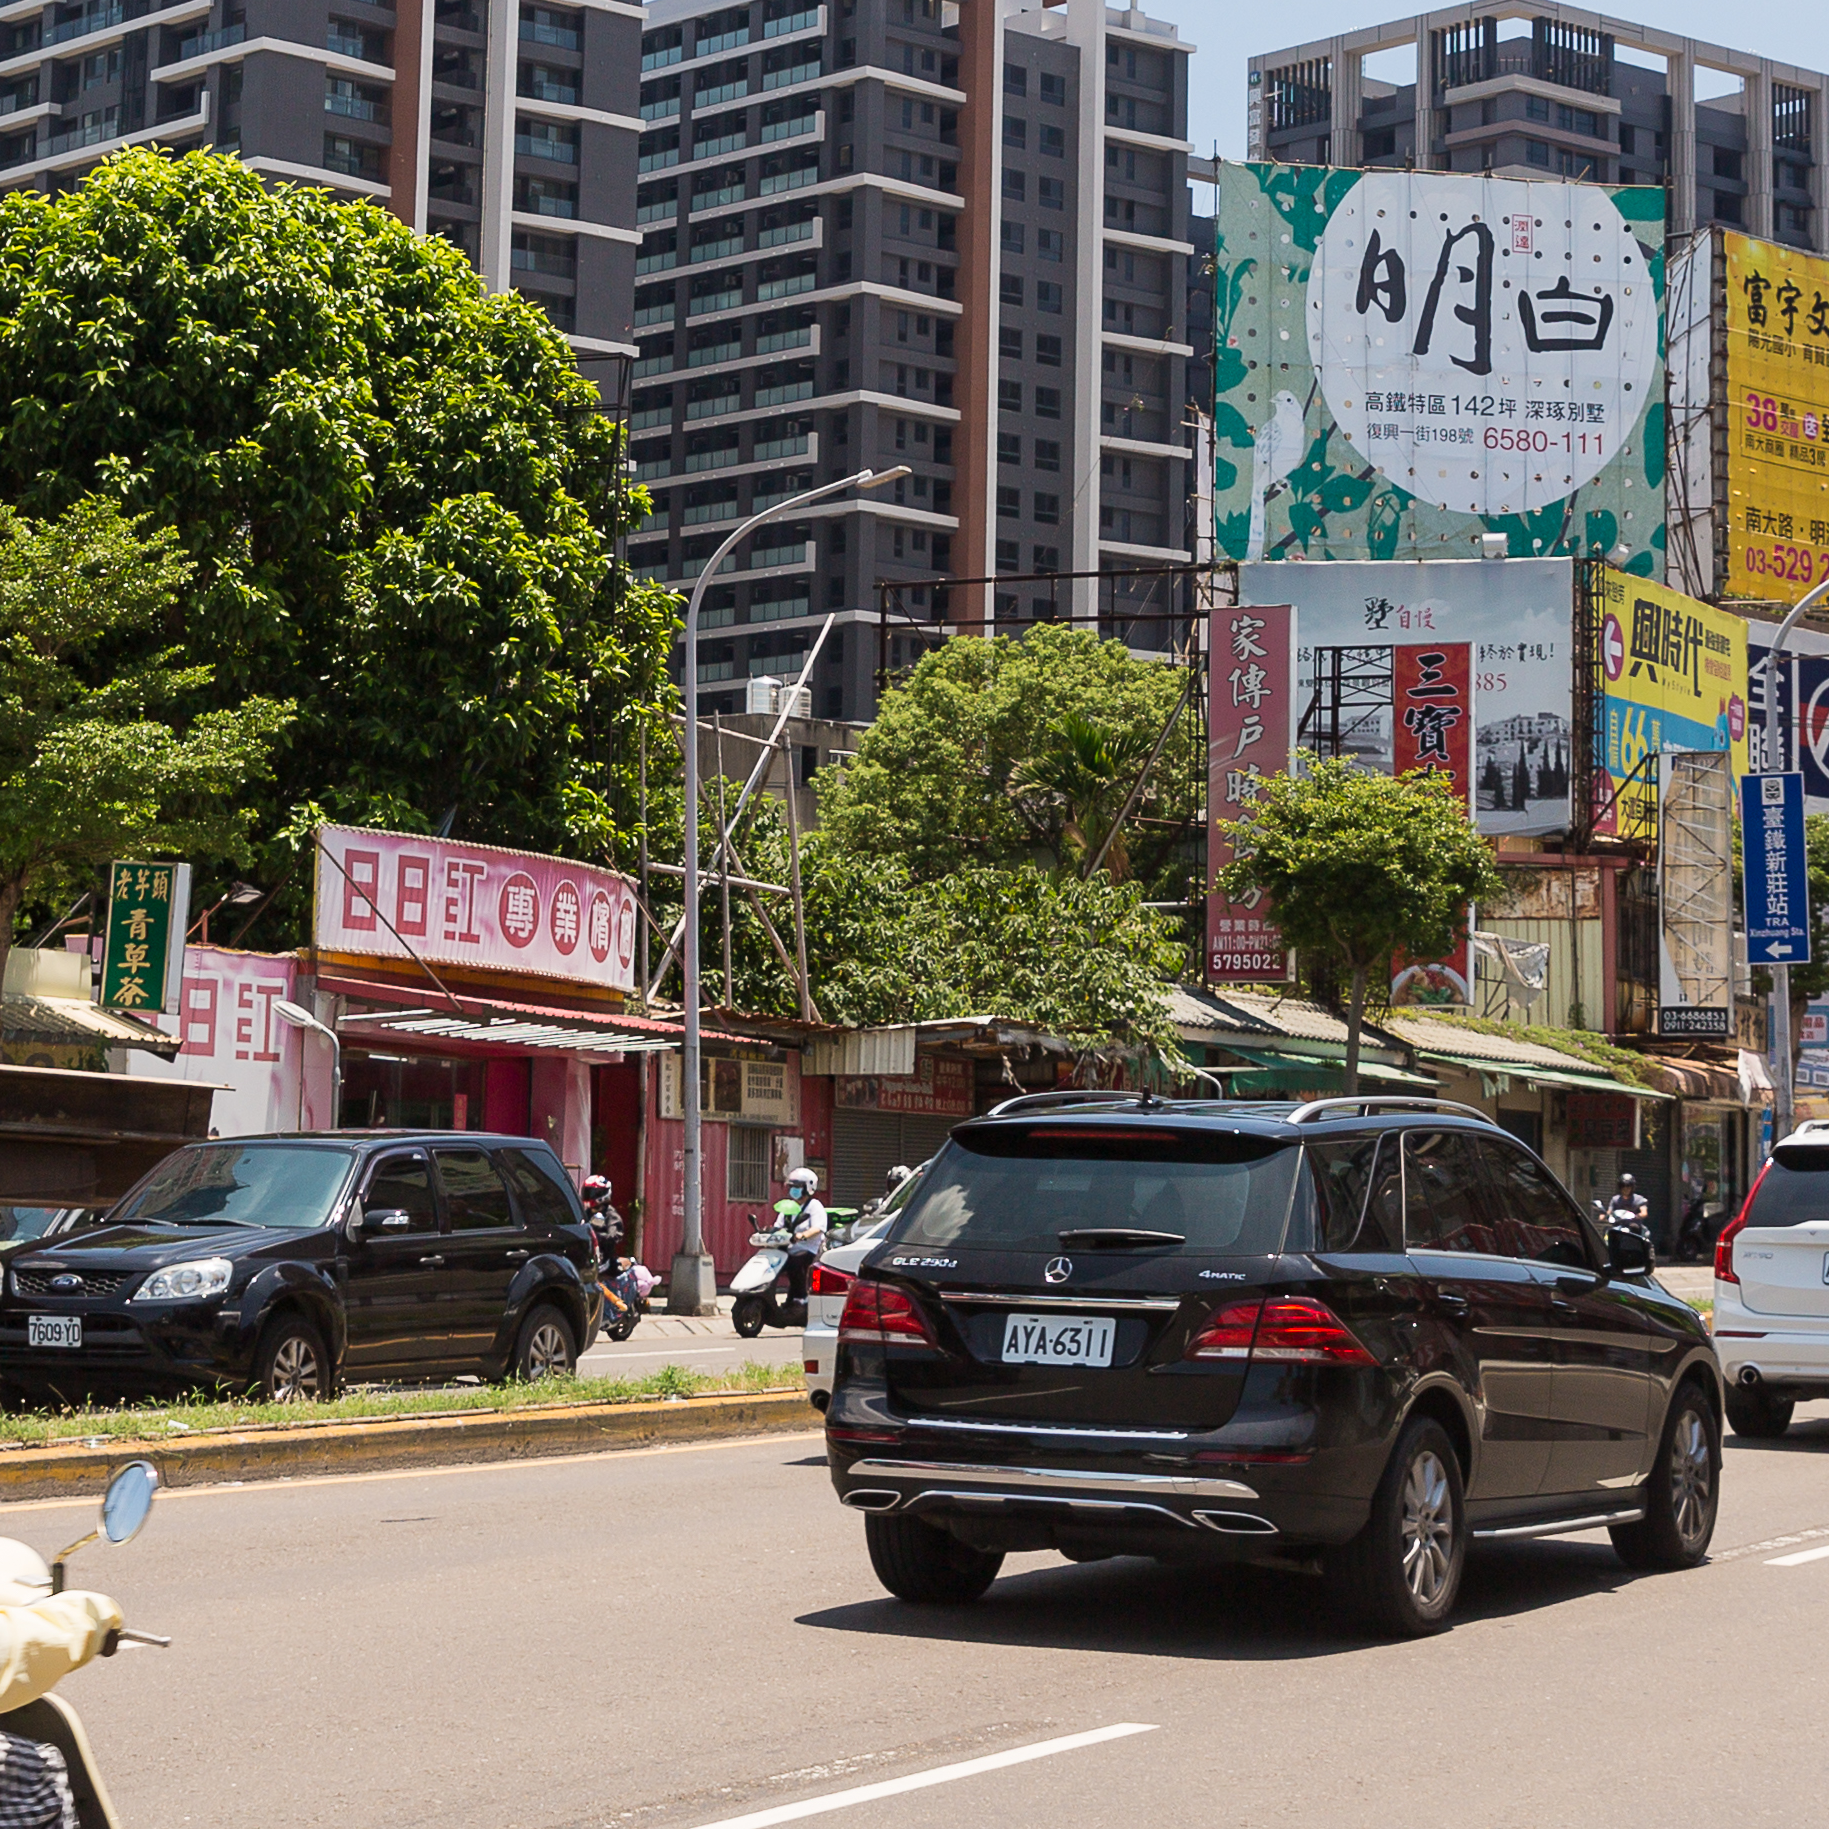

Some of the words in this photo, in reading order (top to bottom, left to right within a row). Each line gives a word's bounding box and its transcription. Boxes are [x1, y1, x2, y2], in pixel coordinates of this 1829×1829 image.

[1356, 222, 1614, 375] 明白
[1746, 393, 1778, 432] 38
[1483, 426, 1603, 456] 6580-111
[1745, 544, 1813, 583] 03-529
[1628, 598, 1703, 698] 興時代
[1404, 653, 1462, 781] 三寶
[1763, 806, 1789, 916] 臺鐵新莊站
[116, 868, 168, 903] 老芋頭
[342, 848, 486, 944] 日日紅
[1749, 927, 1789, 939] Xinzhuang
[1765, 917, 1789, 927] TRA
[112, 908, 155, 1006] 青草茶
[1213, 954, 1281, 970] 5795022
[133, 978, 283, 1062] 日紅
[892, 1257, 918, 1267] GLE
[29, 1323, 81, 1342] 7609-YD
[1005, 1324, 1109, 1359] AYA-6311
